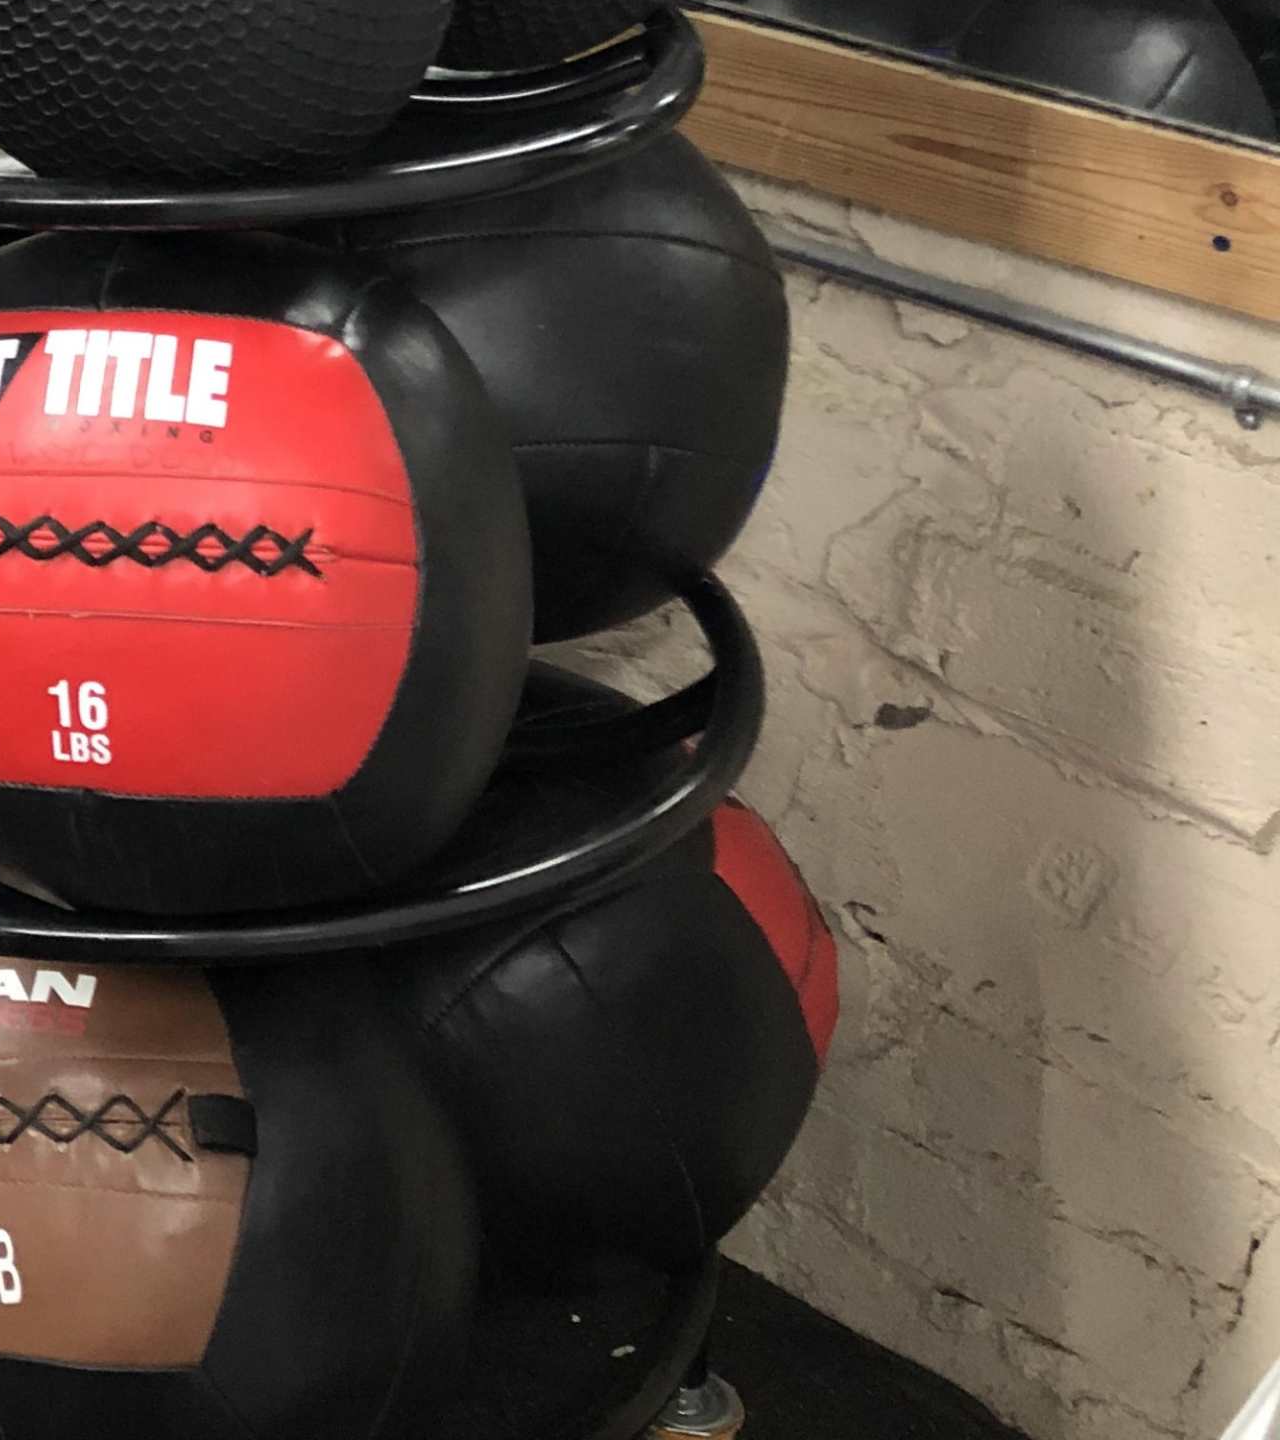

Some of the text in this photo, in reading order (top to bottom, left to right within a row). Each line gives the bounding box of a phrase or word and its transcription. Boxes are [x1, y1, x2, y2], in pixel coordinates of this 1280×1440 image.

[42, 328, 233, 429] TITLE
[47, 679, 109, 731] 16
[51, 729, 112, 765] LBS
